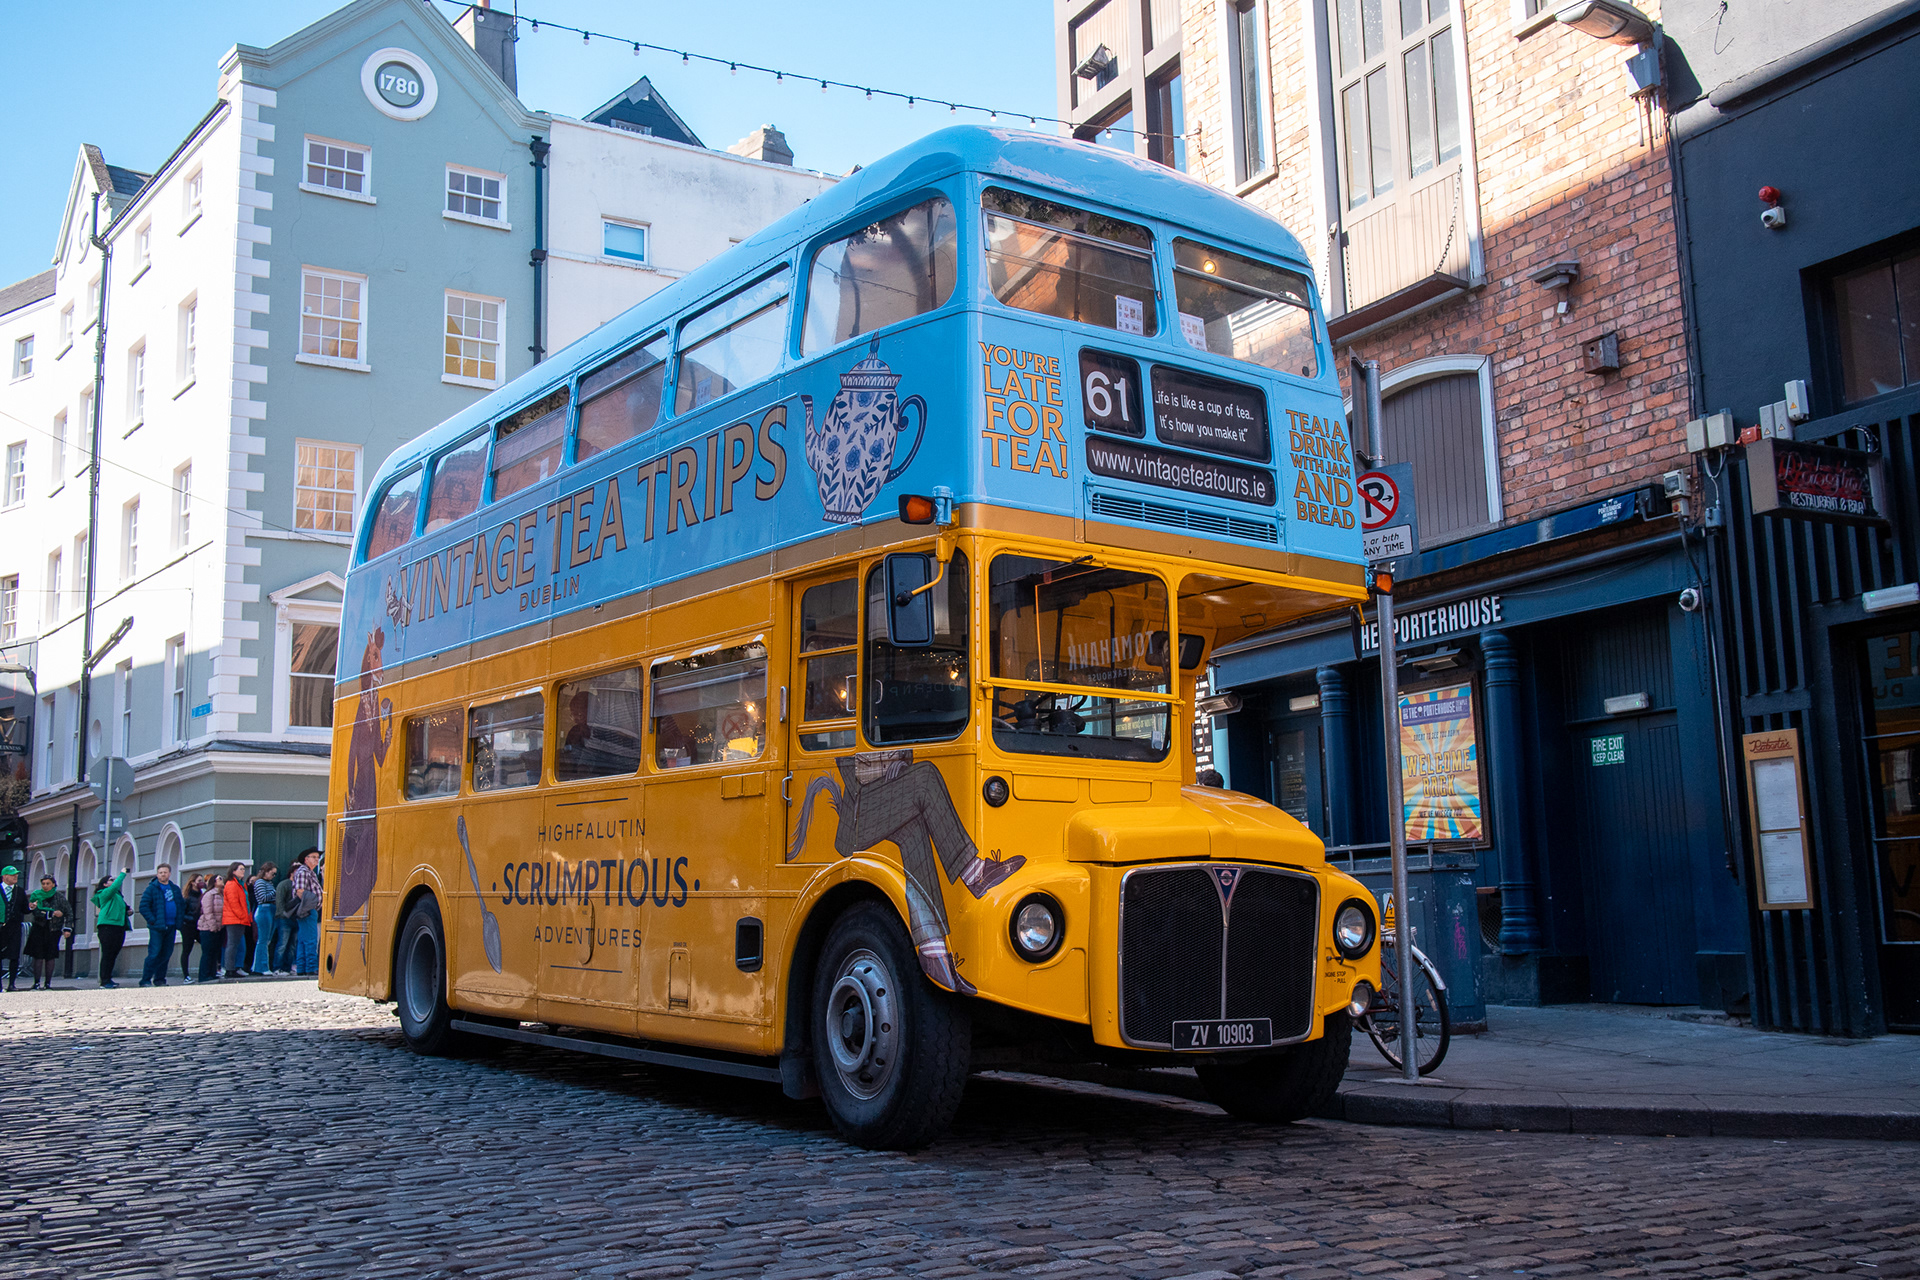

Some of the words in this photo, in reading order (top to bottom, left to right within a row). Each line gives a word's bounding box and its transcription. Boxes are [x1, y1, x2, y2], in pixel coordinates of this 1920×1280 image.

[379, 73, 419, 97] 1780
[978, 341, 1061, 377] YOU'RE
[983, 364, 1063, 407] LATE
[1086, 370, 1131, 422] 61
[985, 394, 1067, 443] FOR
[1171, 393, 1179, 407] is
[1181, 394, 1197, 410] like
[1198, 401, 1205, 412] a
[1206, 402, 1222, 417] cup
[1225, 403, 1234, 417] of
[1175, 417, 1194, 433] how
[1196, 424, 1213, 438] you
[1214, 426, 1238, 441] make
[1285, 408, 1330, 439] TEA!
[1332, 420, 1347, 442] A
[982, 430, 1069, 479] TEA!
[1289, 430, 1351, 464] DRINK
[1091, 446, 1266, 500] www.vintageteatours.ie
[1289, 452, 1325, 474] WITH
[1325, 461, 1351, 479] JAM
[1293, 469, 1354, 508] AND
[1790, 492, 1839, 511] RESTAURANT
[401, 512, 537, 627] VINTAGE
[546, 477, 628, 575] TEA
[637, 404, 788, 543] TRIPS
[1296, 499, 1356, 530] BREAD
[1364, 545, 1381, 557] ANY
[1384, 541, 1405, 552] TIME
[1382, 533, 1399, 543] bith
[520, 575, 580, 612] DUBLIN
[1361, 622, 1379, 651] HE
[1592, 738, 1607, 752] FIRE
[1608, 736, 1623, 751] EXIT
[1593, 752, 1606, 763] KEEP
[1607, 750, 1625, 762] CLEAR
[1405, 748, 1472, 778] WELCOME
[1422, 774, 1457, 799] BACK
[537, 818, 646, 843] HIGHFALUTIN
[502, 856, 689, 908] SCRUMPTIOUS
[533, 926, 642, 948] ADVENTURES
[1191, 1025, 1210, 1046] ZV
[1217, 1023, 1254, 1045] 10903
